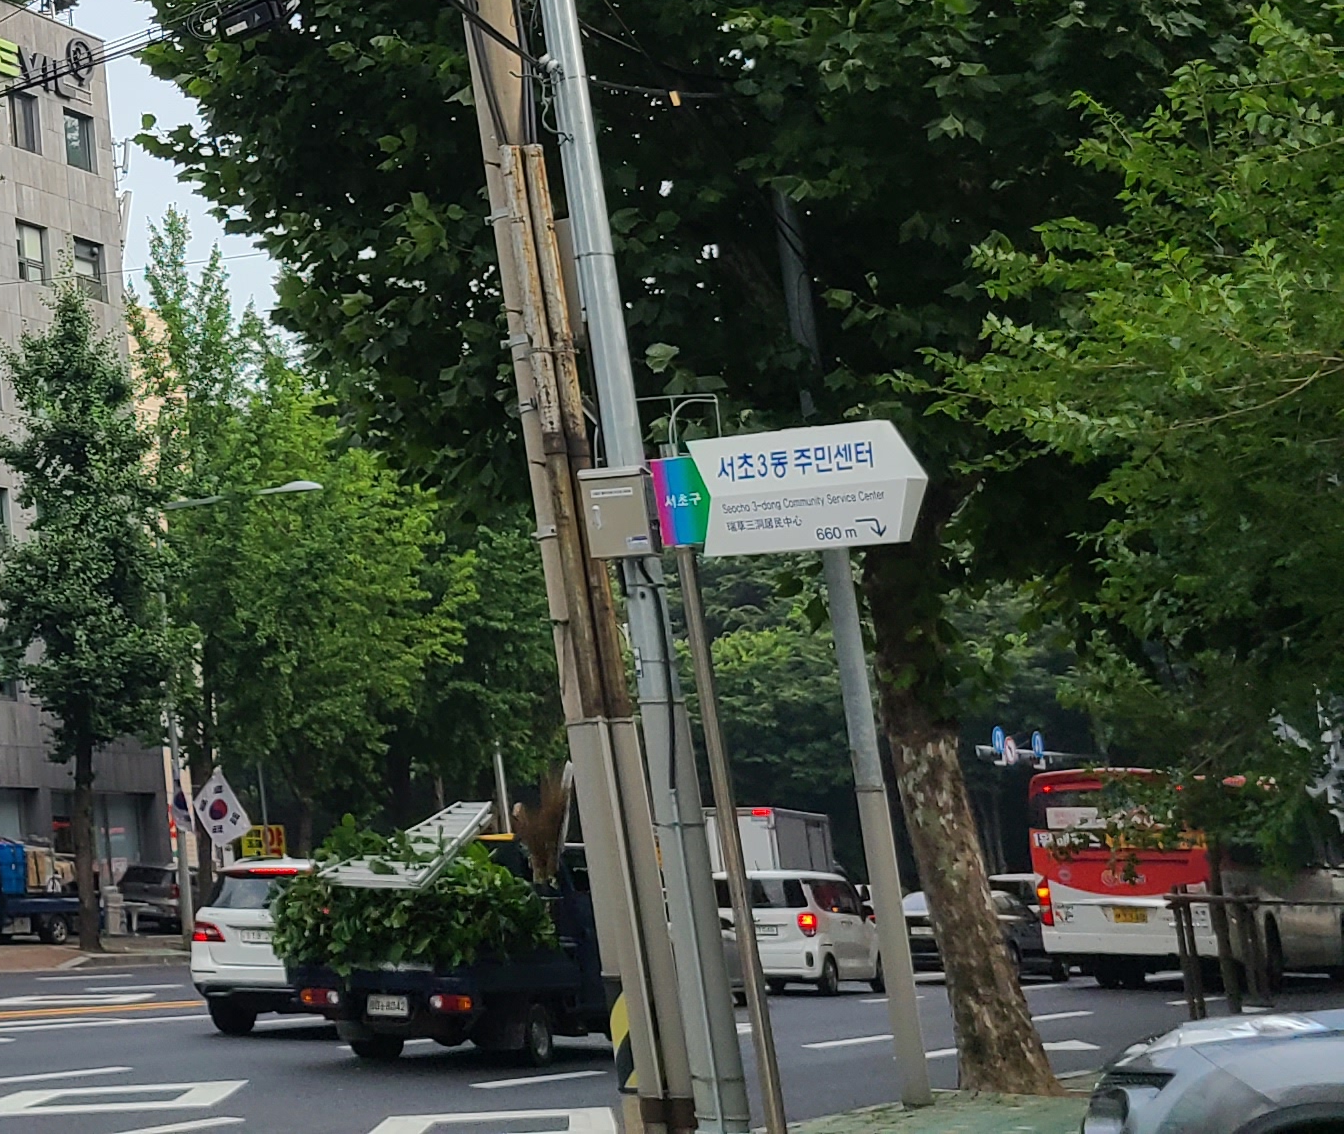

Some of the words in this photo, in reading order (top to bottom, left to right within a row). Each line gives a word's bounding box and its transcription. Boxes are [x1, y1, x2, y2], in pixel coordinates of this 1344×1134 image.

[717, 450, 789, 482] 서초3동
[793, 441, 874, 475] 주민센터
[664, 492, 702, 509] 서초구
[721, 503, 751, 515] Seocho
[752, 500, 782, 512] 3-dong
[782, 497, 825, 509] Community
[826, 493, 857, 505] Service
[858, 490, 885, 501] Center
[815, 527, 842, 541] 660
[845, 527, 858, 539] m
